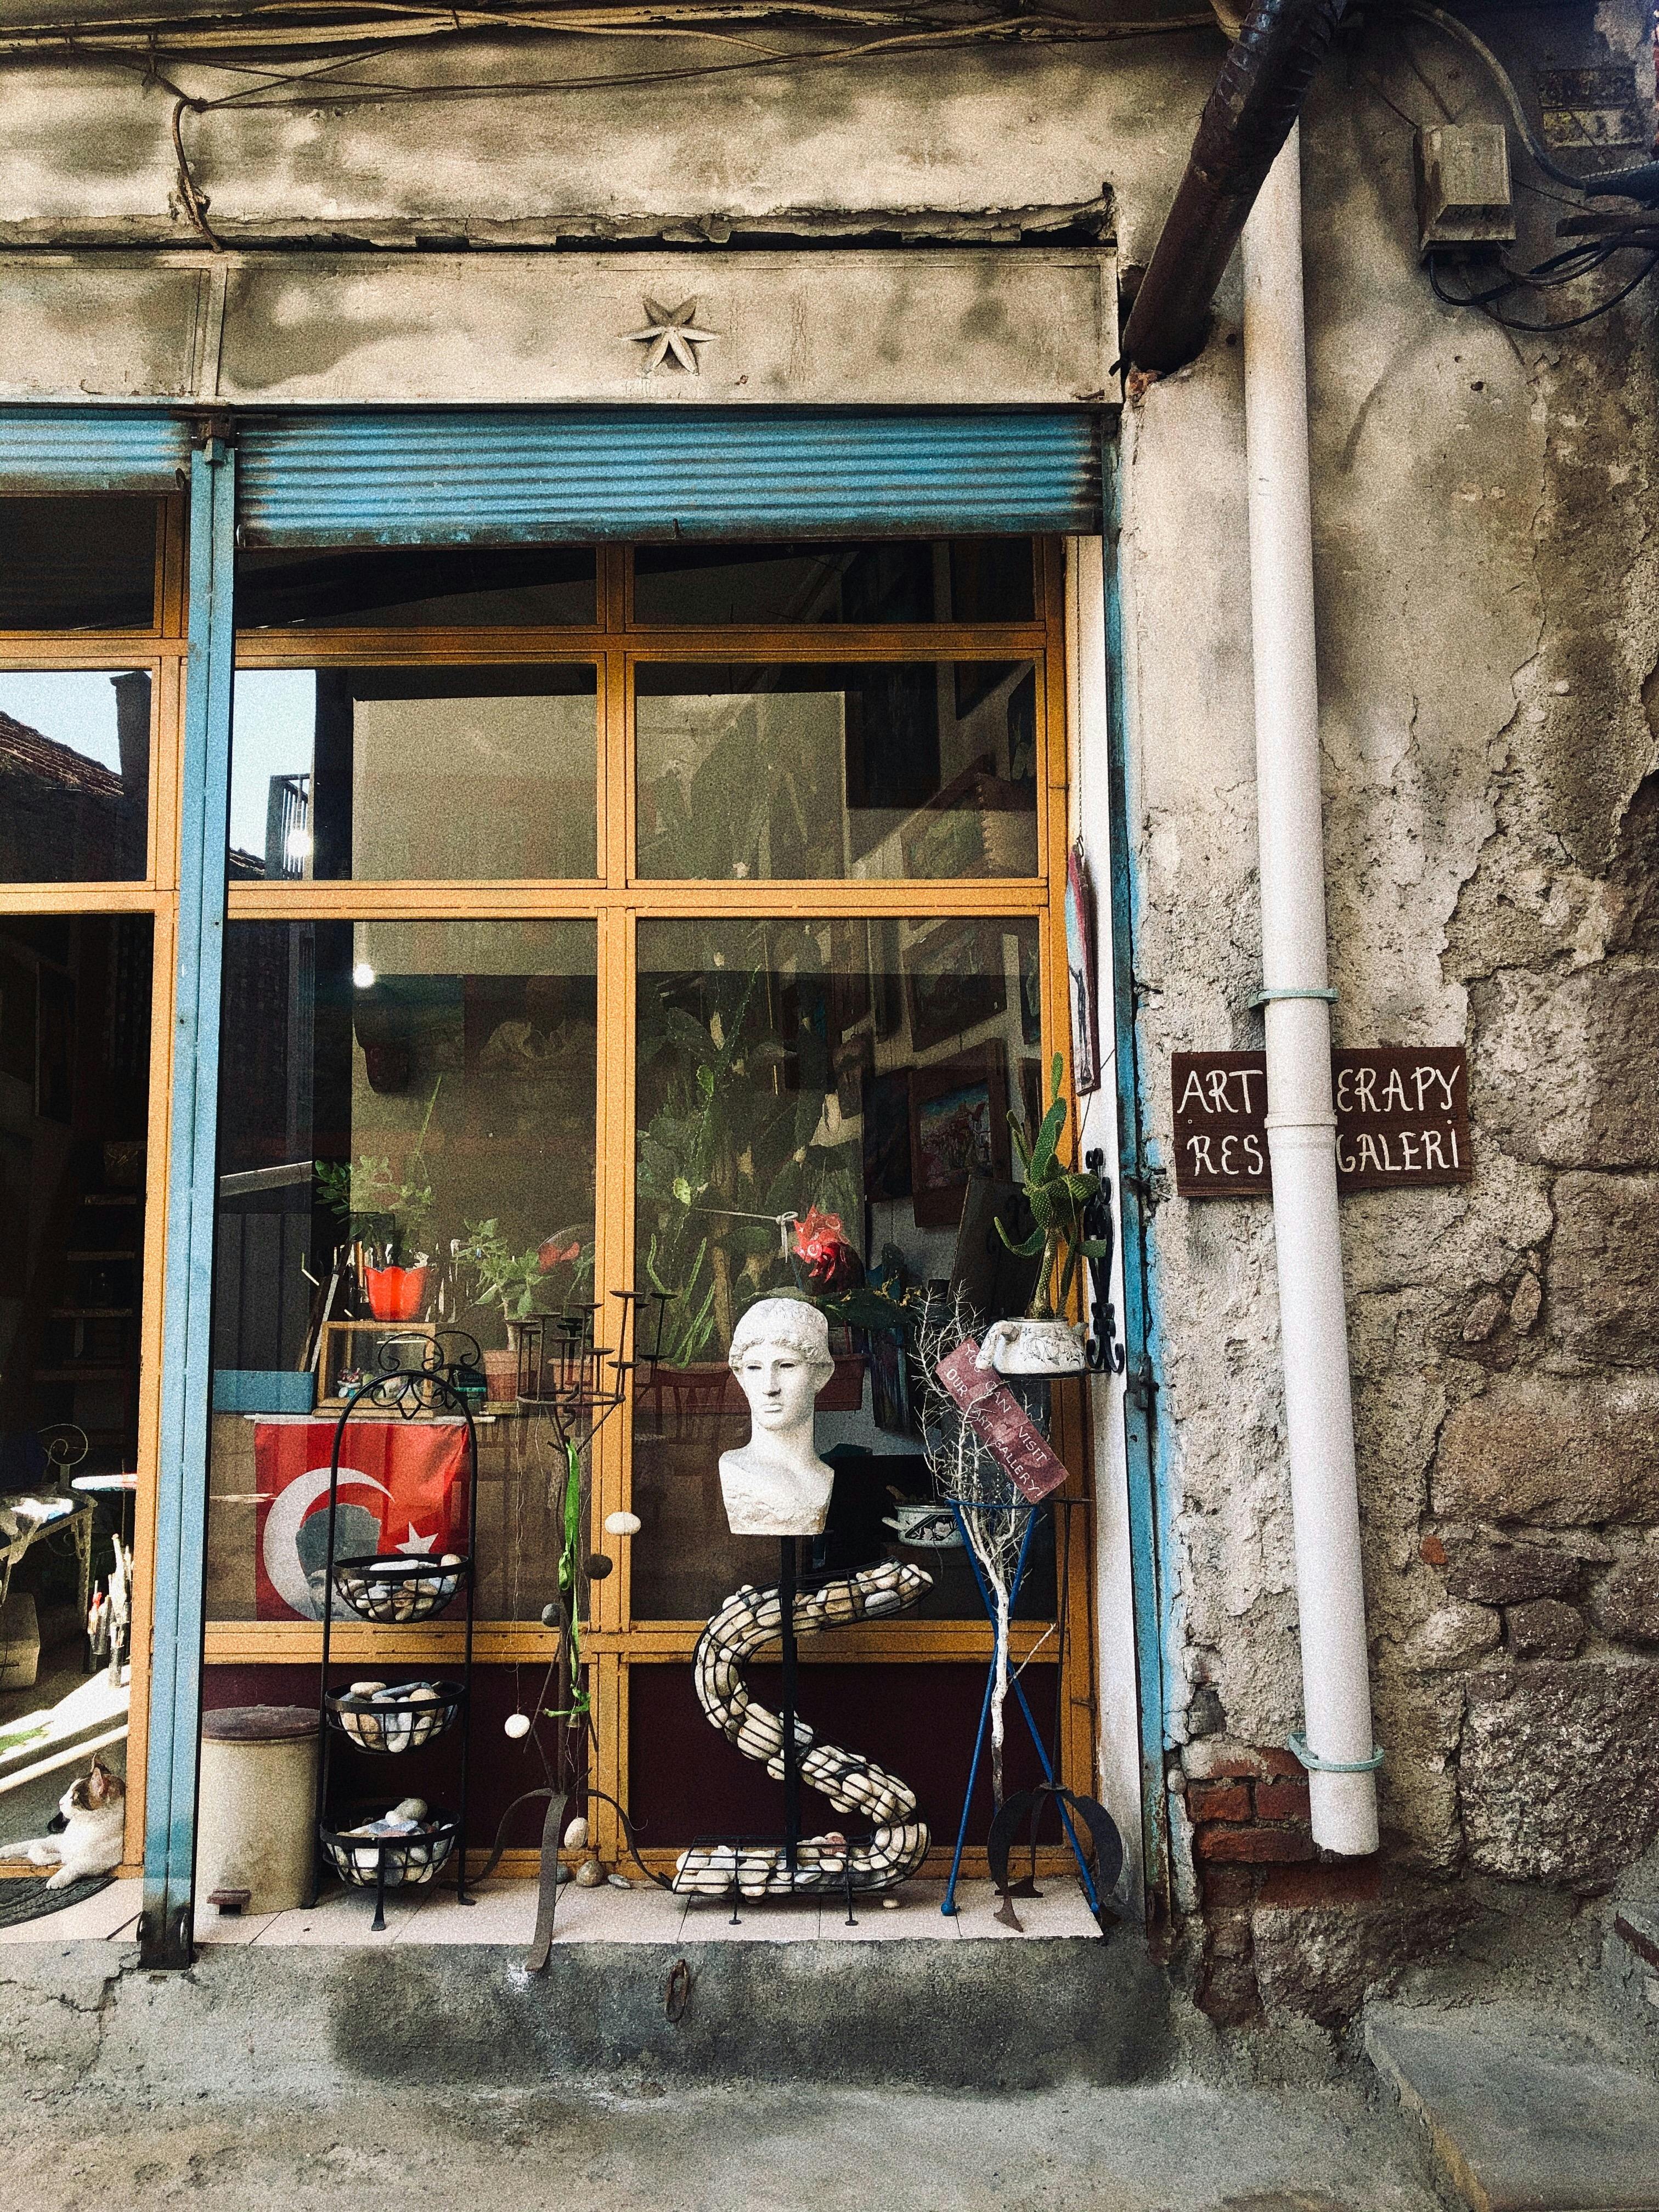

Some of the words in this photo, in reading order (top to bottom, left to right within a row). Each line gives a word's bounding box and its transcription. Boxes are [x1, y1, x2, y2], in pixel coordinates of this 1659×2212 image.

[1177, 1070, 1263, 1114] ART
[1337, 1065, 1460, 1113] ERAPY
[1186, 1134, 1263, 1177] RES
[946, 1368, 968, 1397] OUR
[971, 1409, 993, 1431] ART
[995, 1438, 1043, 1499] GALLERY!
[1019, 1426, 1047, 1462] VISIT
